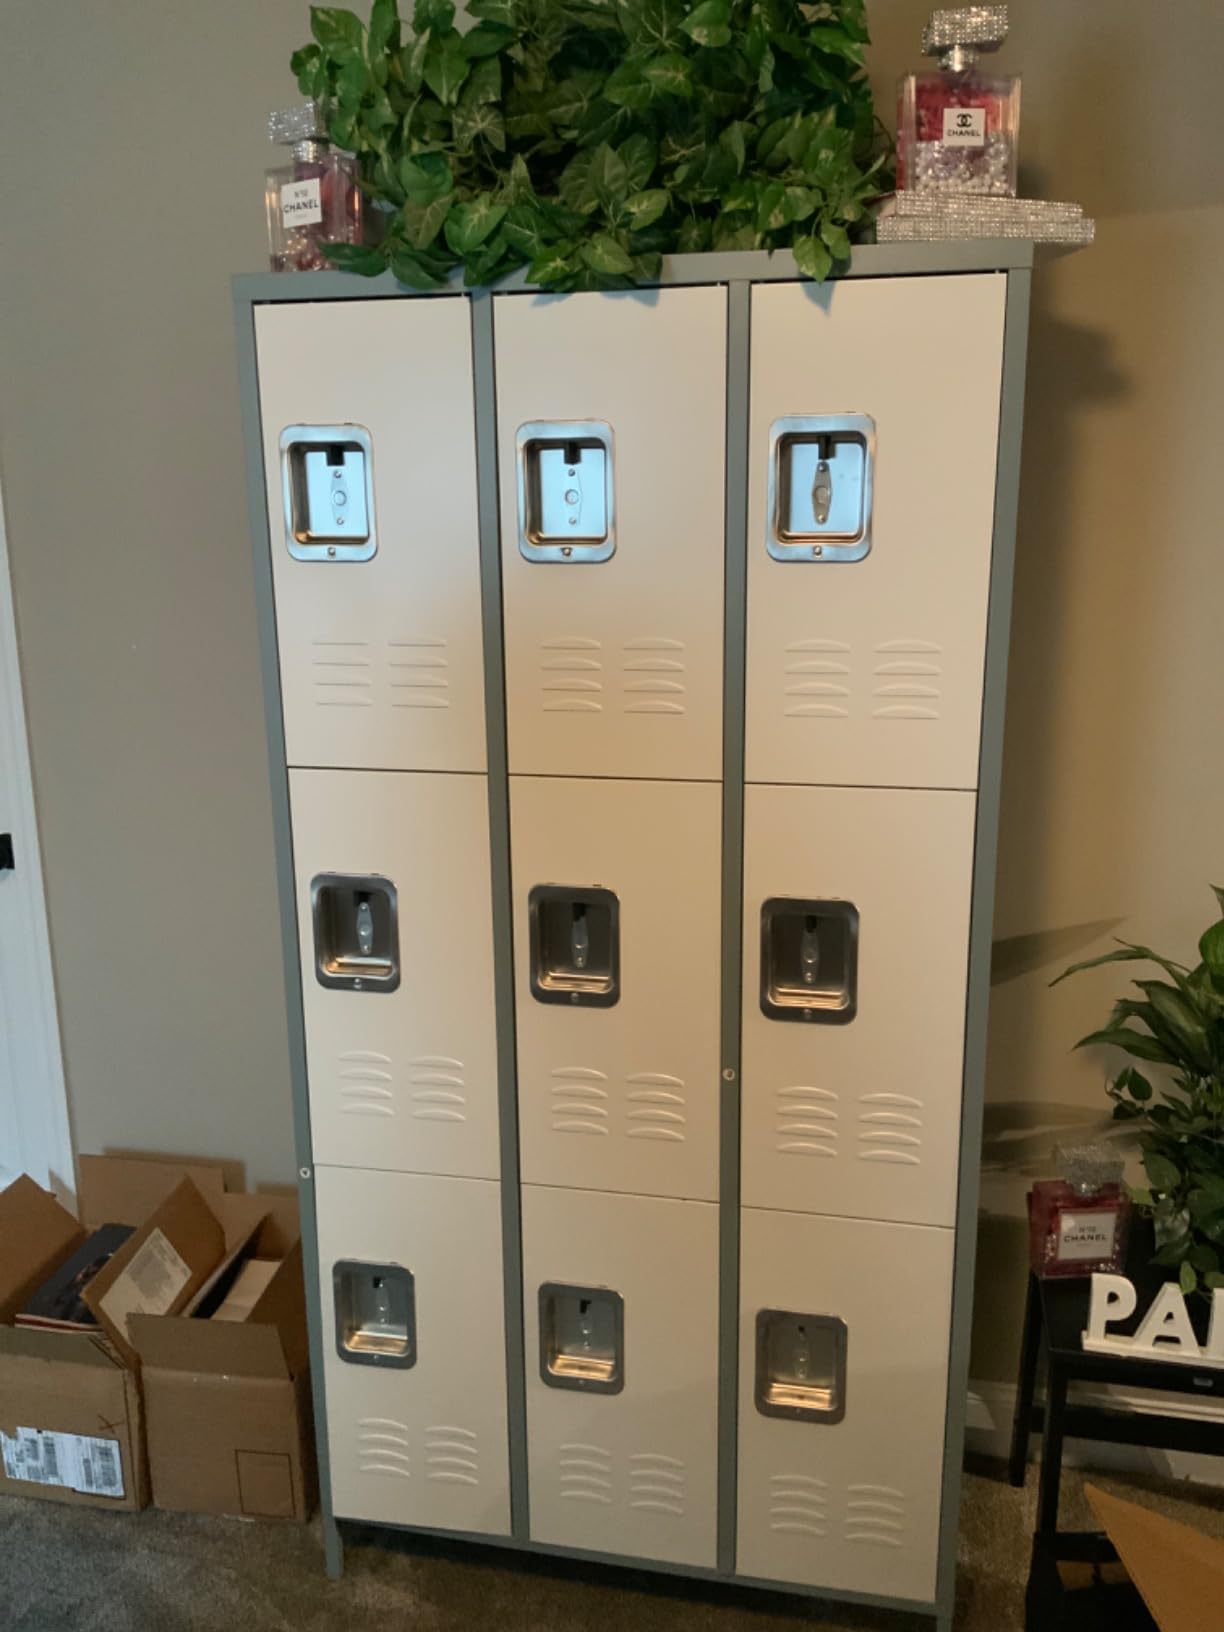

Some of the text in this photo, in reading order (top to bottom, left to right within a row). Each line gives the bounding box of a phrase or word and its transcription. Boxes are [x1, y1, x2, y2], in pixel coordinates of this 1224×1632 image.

[947, 129, 981, 137] CHANEL
[283, 199, 319, 213] CHANEL
[1063, 1233, 1107, 1243] CHANEL
[1087, 1272, 1224, 1357] PA
